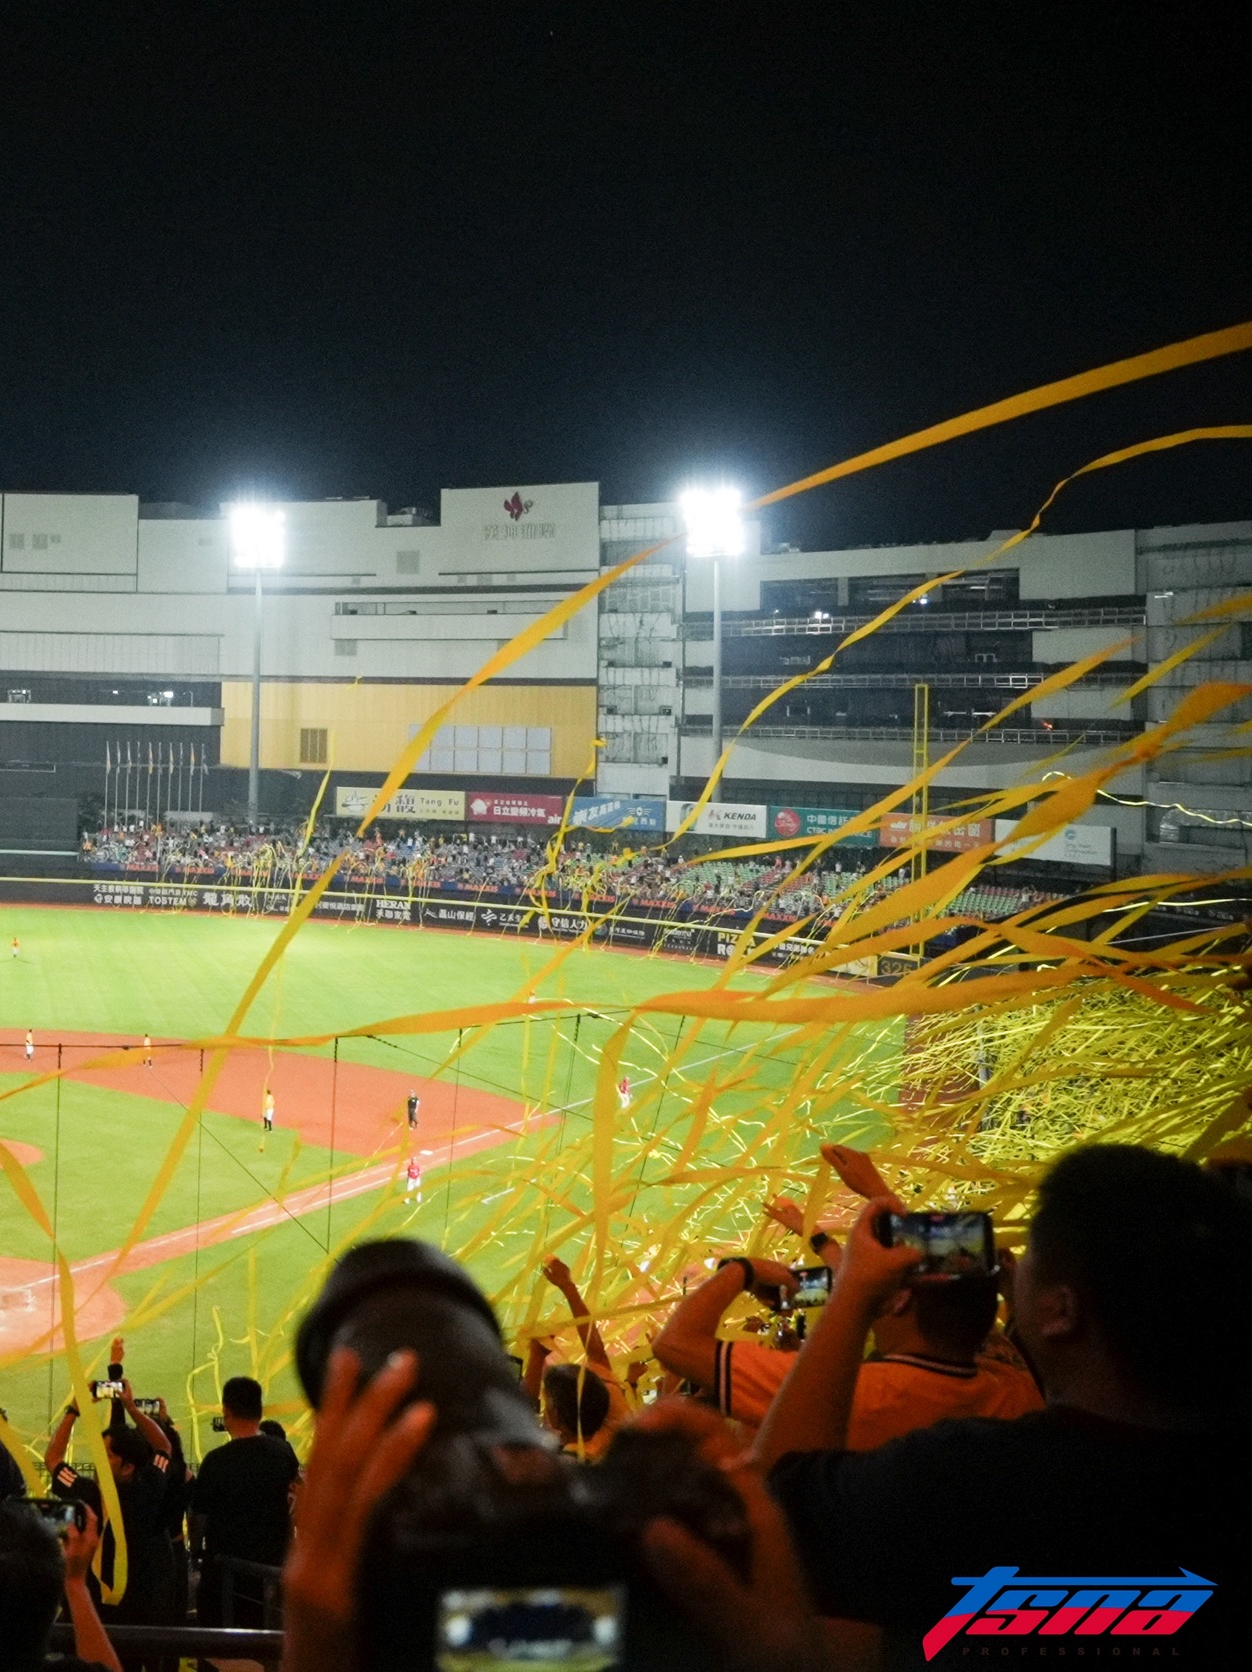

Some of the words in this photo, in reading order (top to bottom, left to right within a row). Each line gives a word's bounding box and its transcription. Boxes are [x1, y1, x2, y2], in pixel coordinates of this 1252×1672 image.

[420, 797, 442, 807] Tang
[448, 798, 459, 806] Fu
[547, 814, 562, 824] air
[724, 812, 757, 821] KENDA
[126, 864, 159, 872] MAXXIS
[351, 876, 383, 884] MAXXIS
[464, 884, 498, 892] MAXXIS
[149, 896, 187, 906] TOSTEM
[376, 900, 411, 910] HERAN
[638, 899, 675, 909] MAXXIS
[552, 917, 588, 930] 守信人力
[717, 932, 756, 947] PIZA
